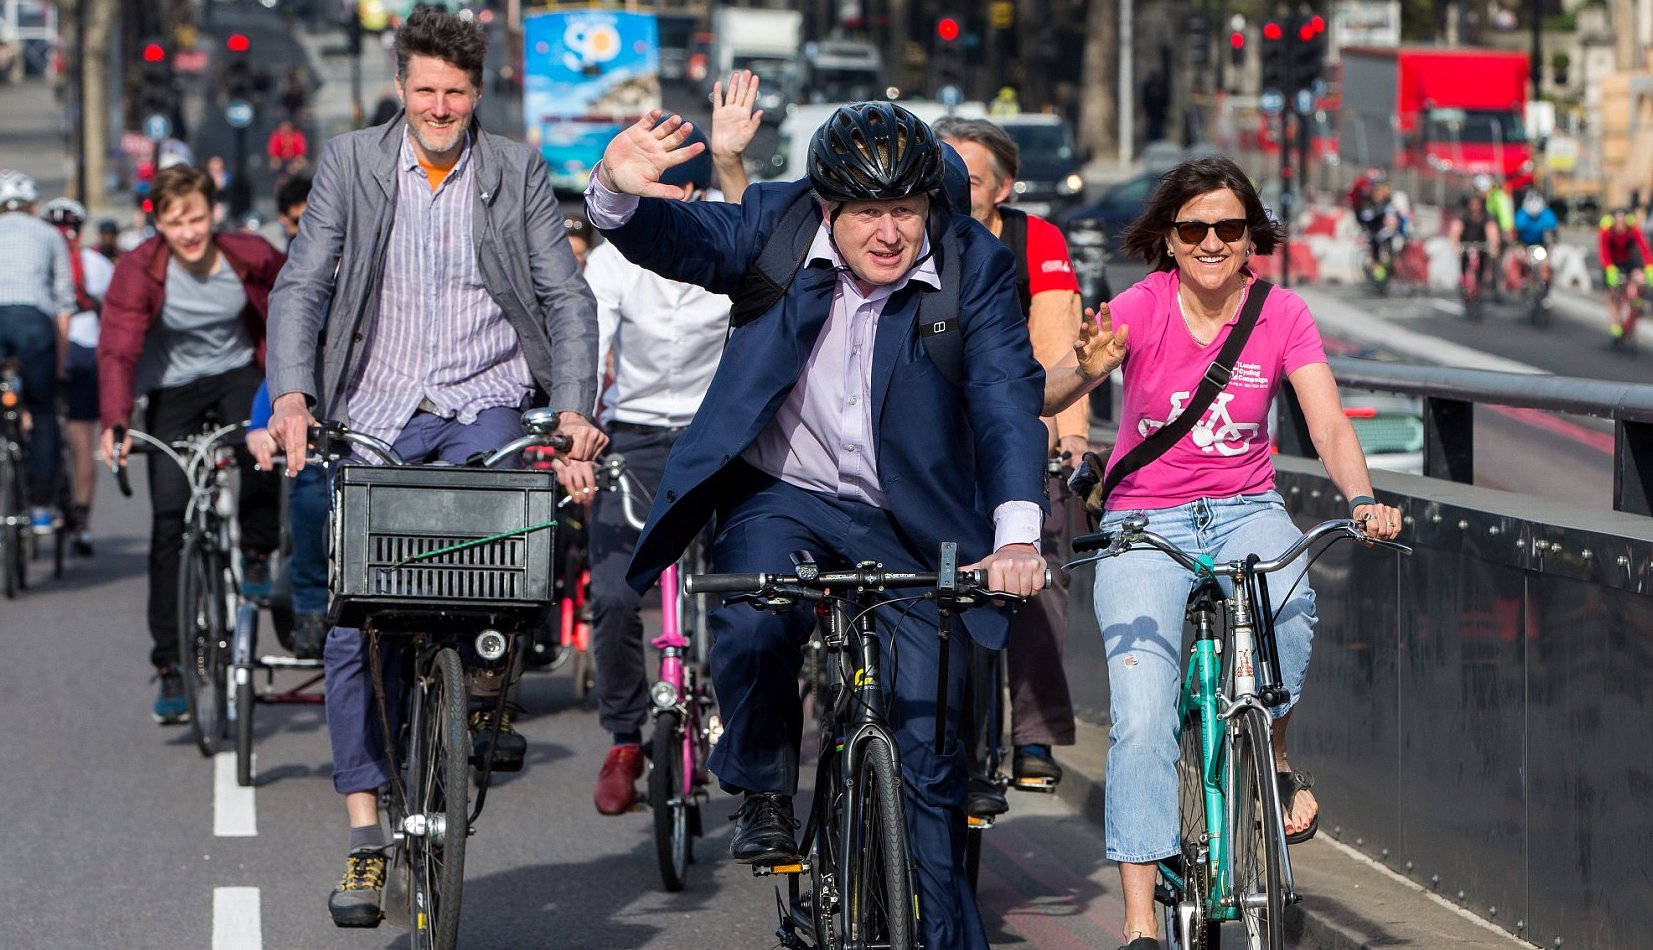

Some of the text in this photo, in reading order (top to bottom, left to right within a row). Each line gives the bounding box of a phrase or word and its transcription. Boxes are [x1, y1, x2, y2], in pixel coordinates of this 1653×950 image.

[1239, 362, 1261, 370] London
[1238, 369, 1261, 377] Cycling
[1238, 375, 1268, 383] Campaign
